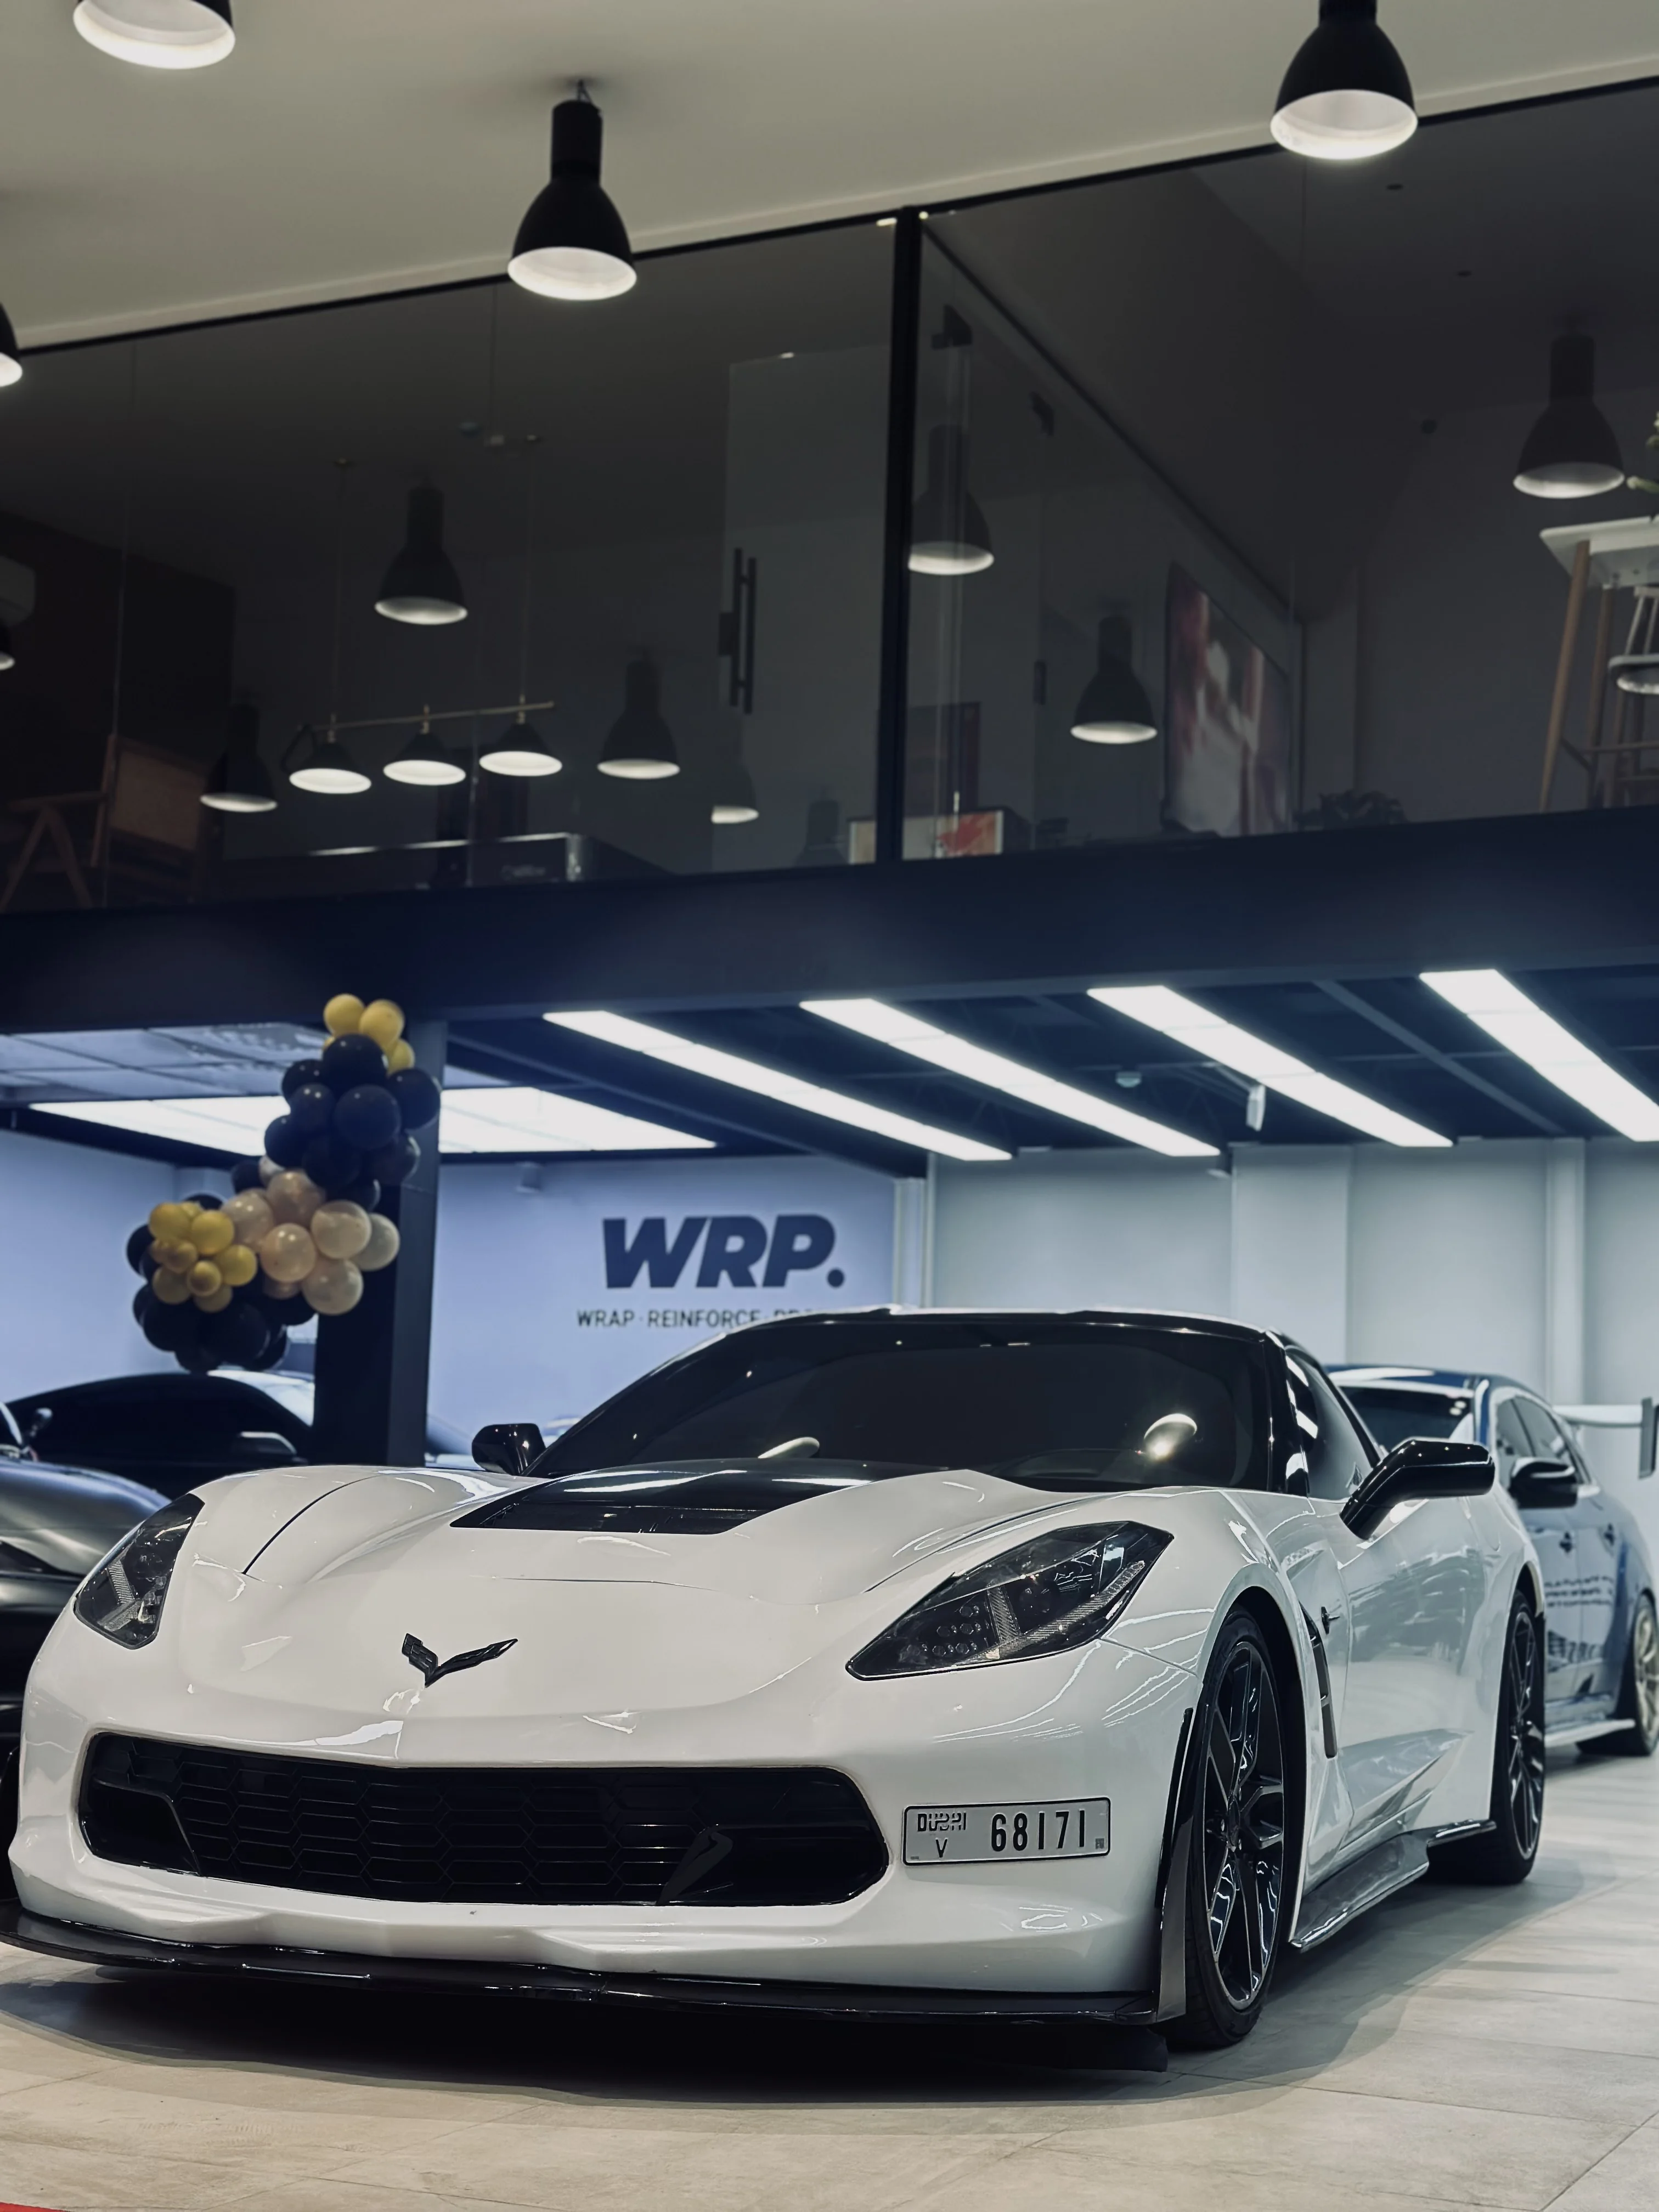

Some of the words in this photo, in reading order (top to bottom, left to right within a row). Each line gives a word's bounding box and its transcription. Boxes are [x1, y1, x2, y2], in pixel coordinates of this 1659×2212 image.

[602, 1214, 845, 1289] WRP.
[577, 1309, 635, 1327] WRAP
[991, 1809, 1085, 1852] 68171
[935, 1838, 948, 1858] V
